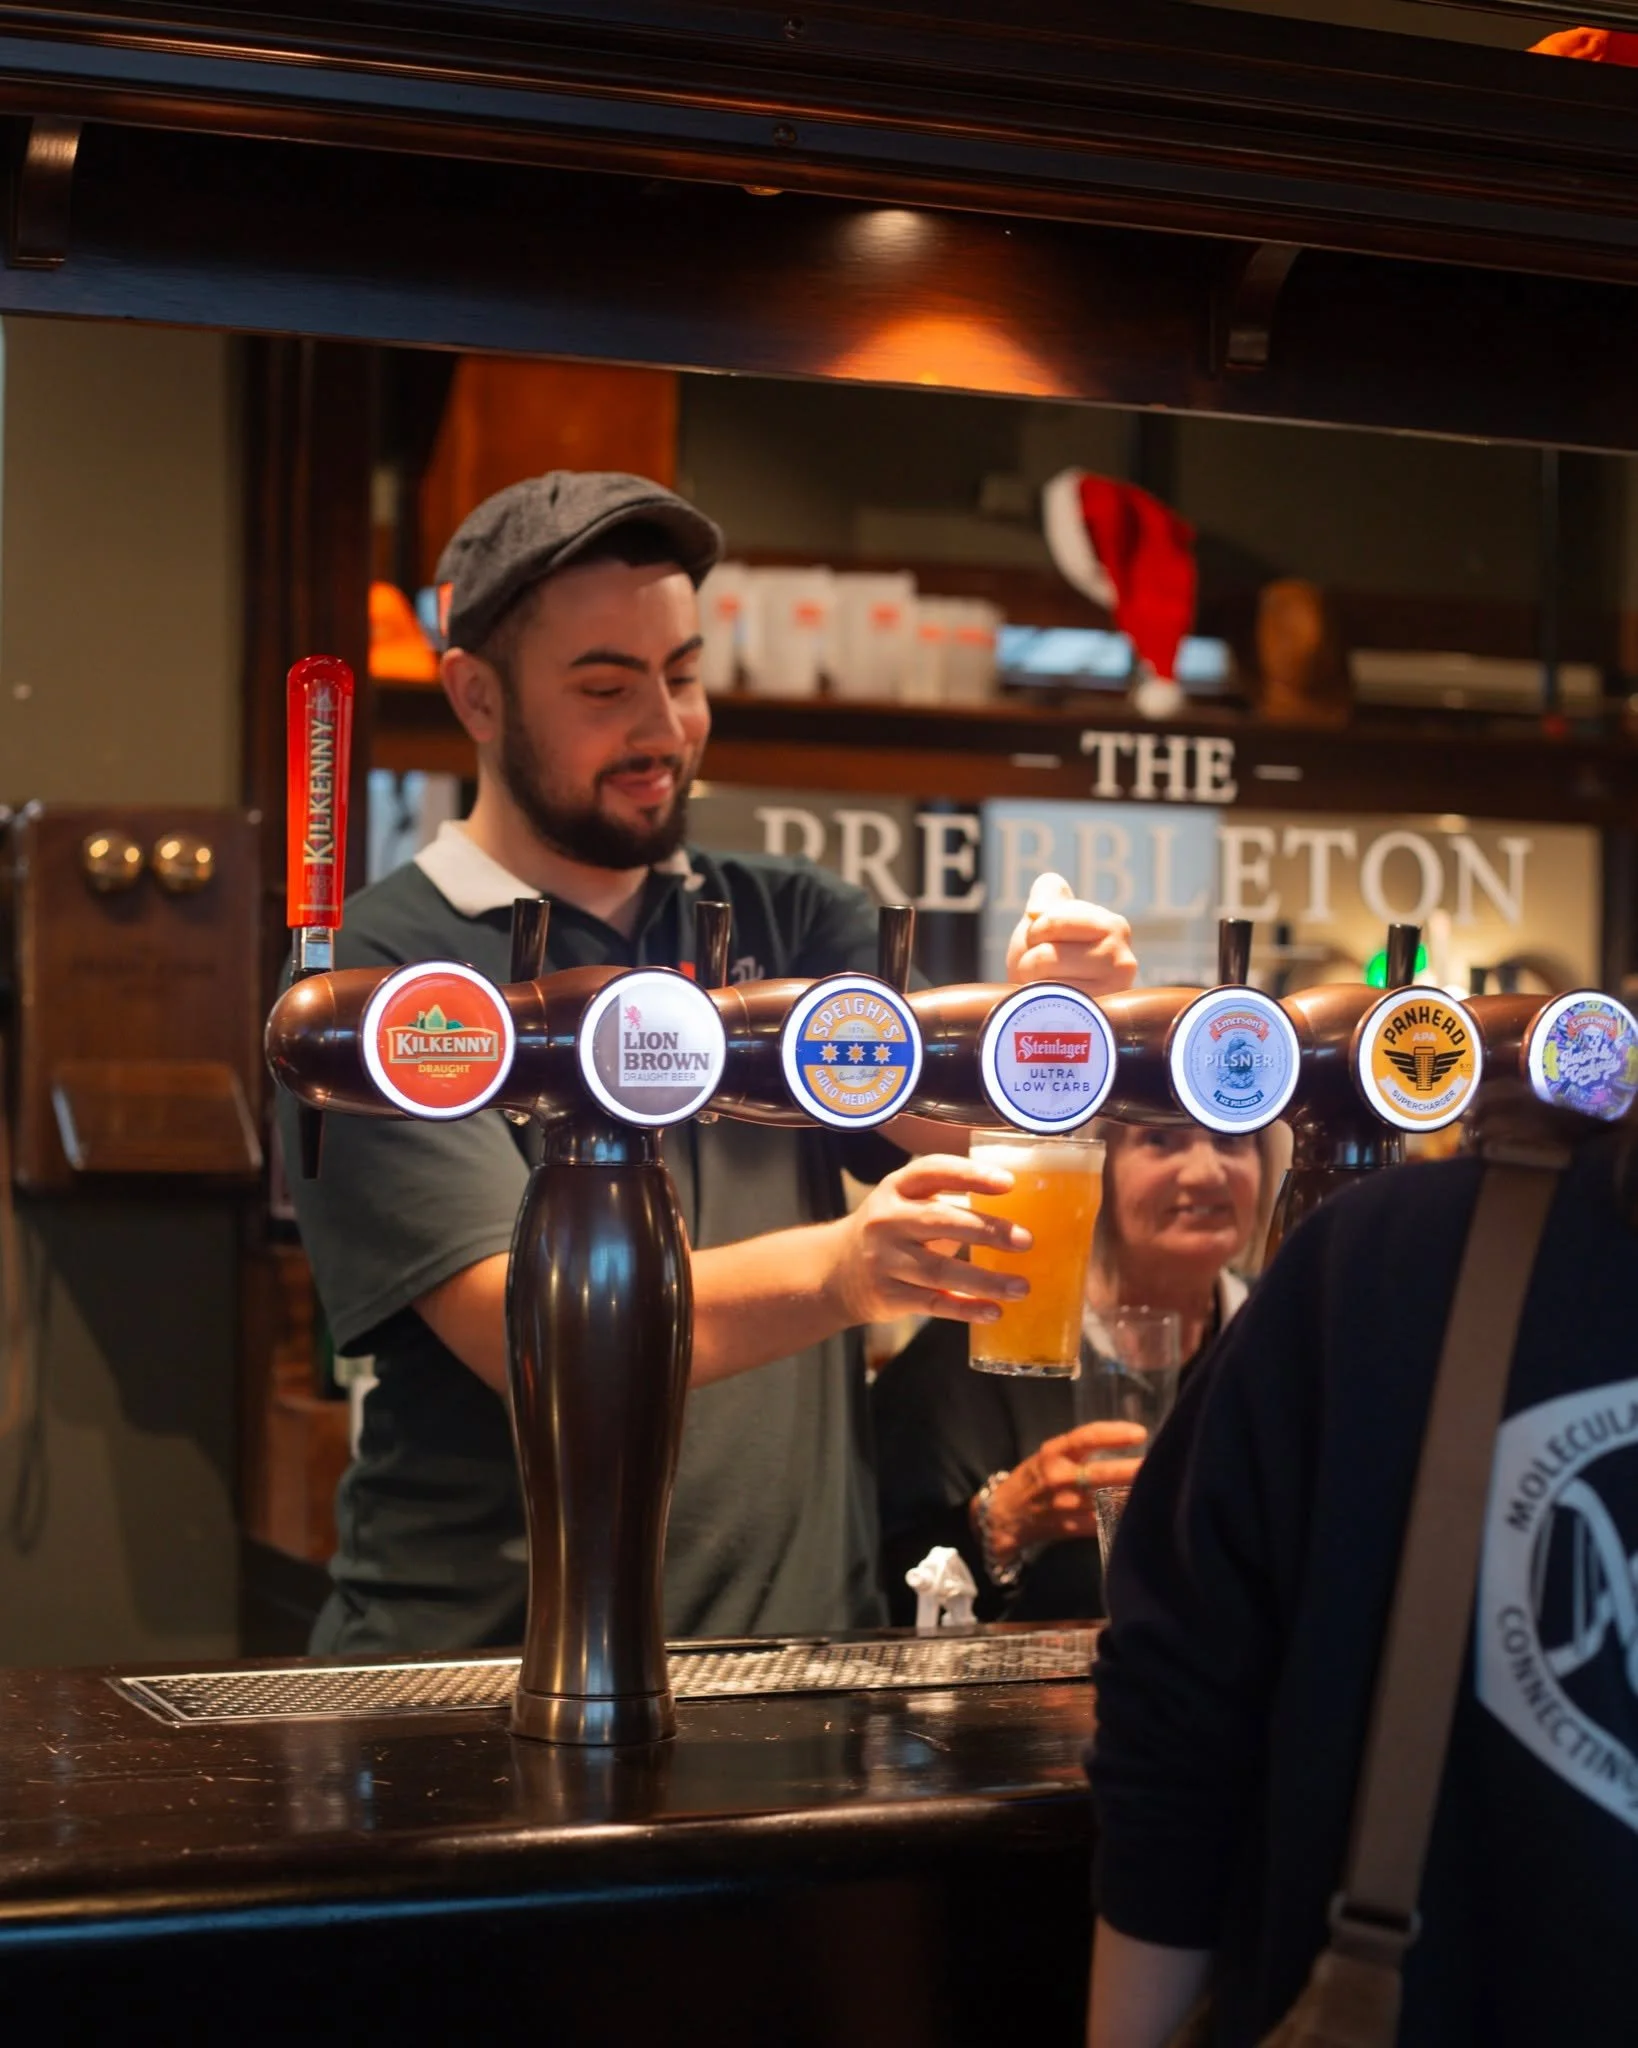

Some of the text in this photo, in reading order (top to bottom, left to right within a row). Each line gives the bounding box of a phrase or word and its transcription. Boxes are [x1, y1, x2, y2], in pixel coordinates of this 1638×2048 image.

[1081, 730, 1237, 803] THE
[304, 718, 335, 865] KILKENNY
[754, 805, 1534, 927] PREBBLETON
[812, 998, 900, 1039] SPEIGHT'S
[1383, 1006, 1466, 1046] PANHEAD
[396, 1033, 493, 1056] KILKENNY
[624, 1032, 679, 1050] LION
[1018, 1036, 1088, 1059] Steinlager
[418, 1064, 471, 1073] DRAUGHT
[624, 1052, 710, 1070] BROWN
[1204, 1054, 1274, 1067] PILSNER
[624, 1073, 696, 1081] DRAUGHT BEER
[1030, 1068, 1076, 1079] ULTRA
[816, 1069, 839, 1098] GOLD
[840, 1090, 880, 1106] MEDAL
[880, 1070, 898, 1093] ALE
[1014, 1082, 1091, 1092] LOW CARB
